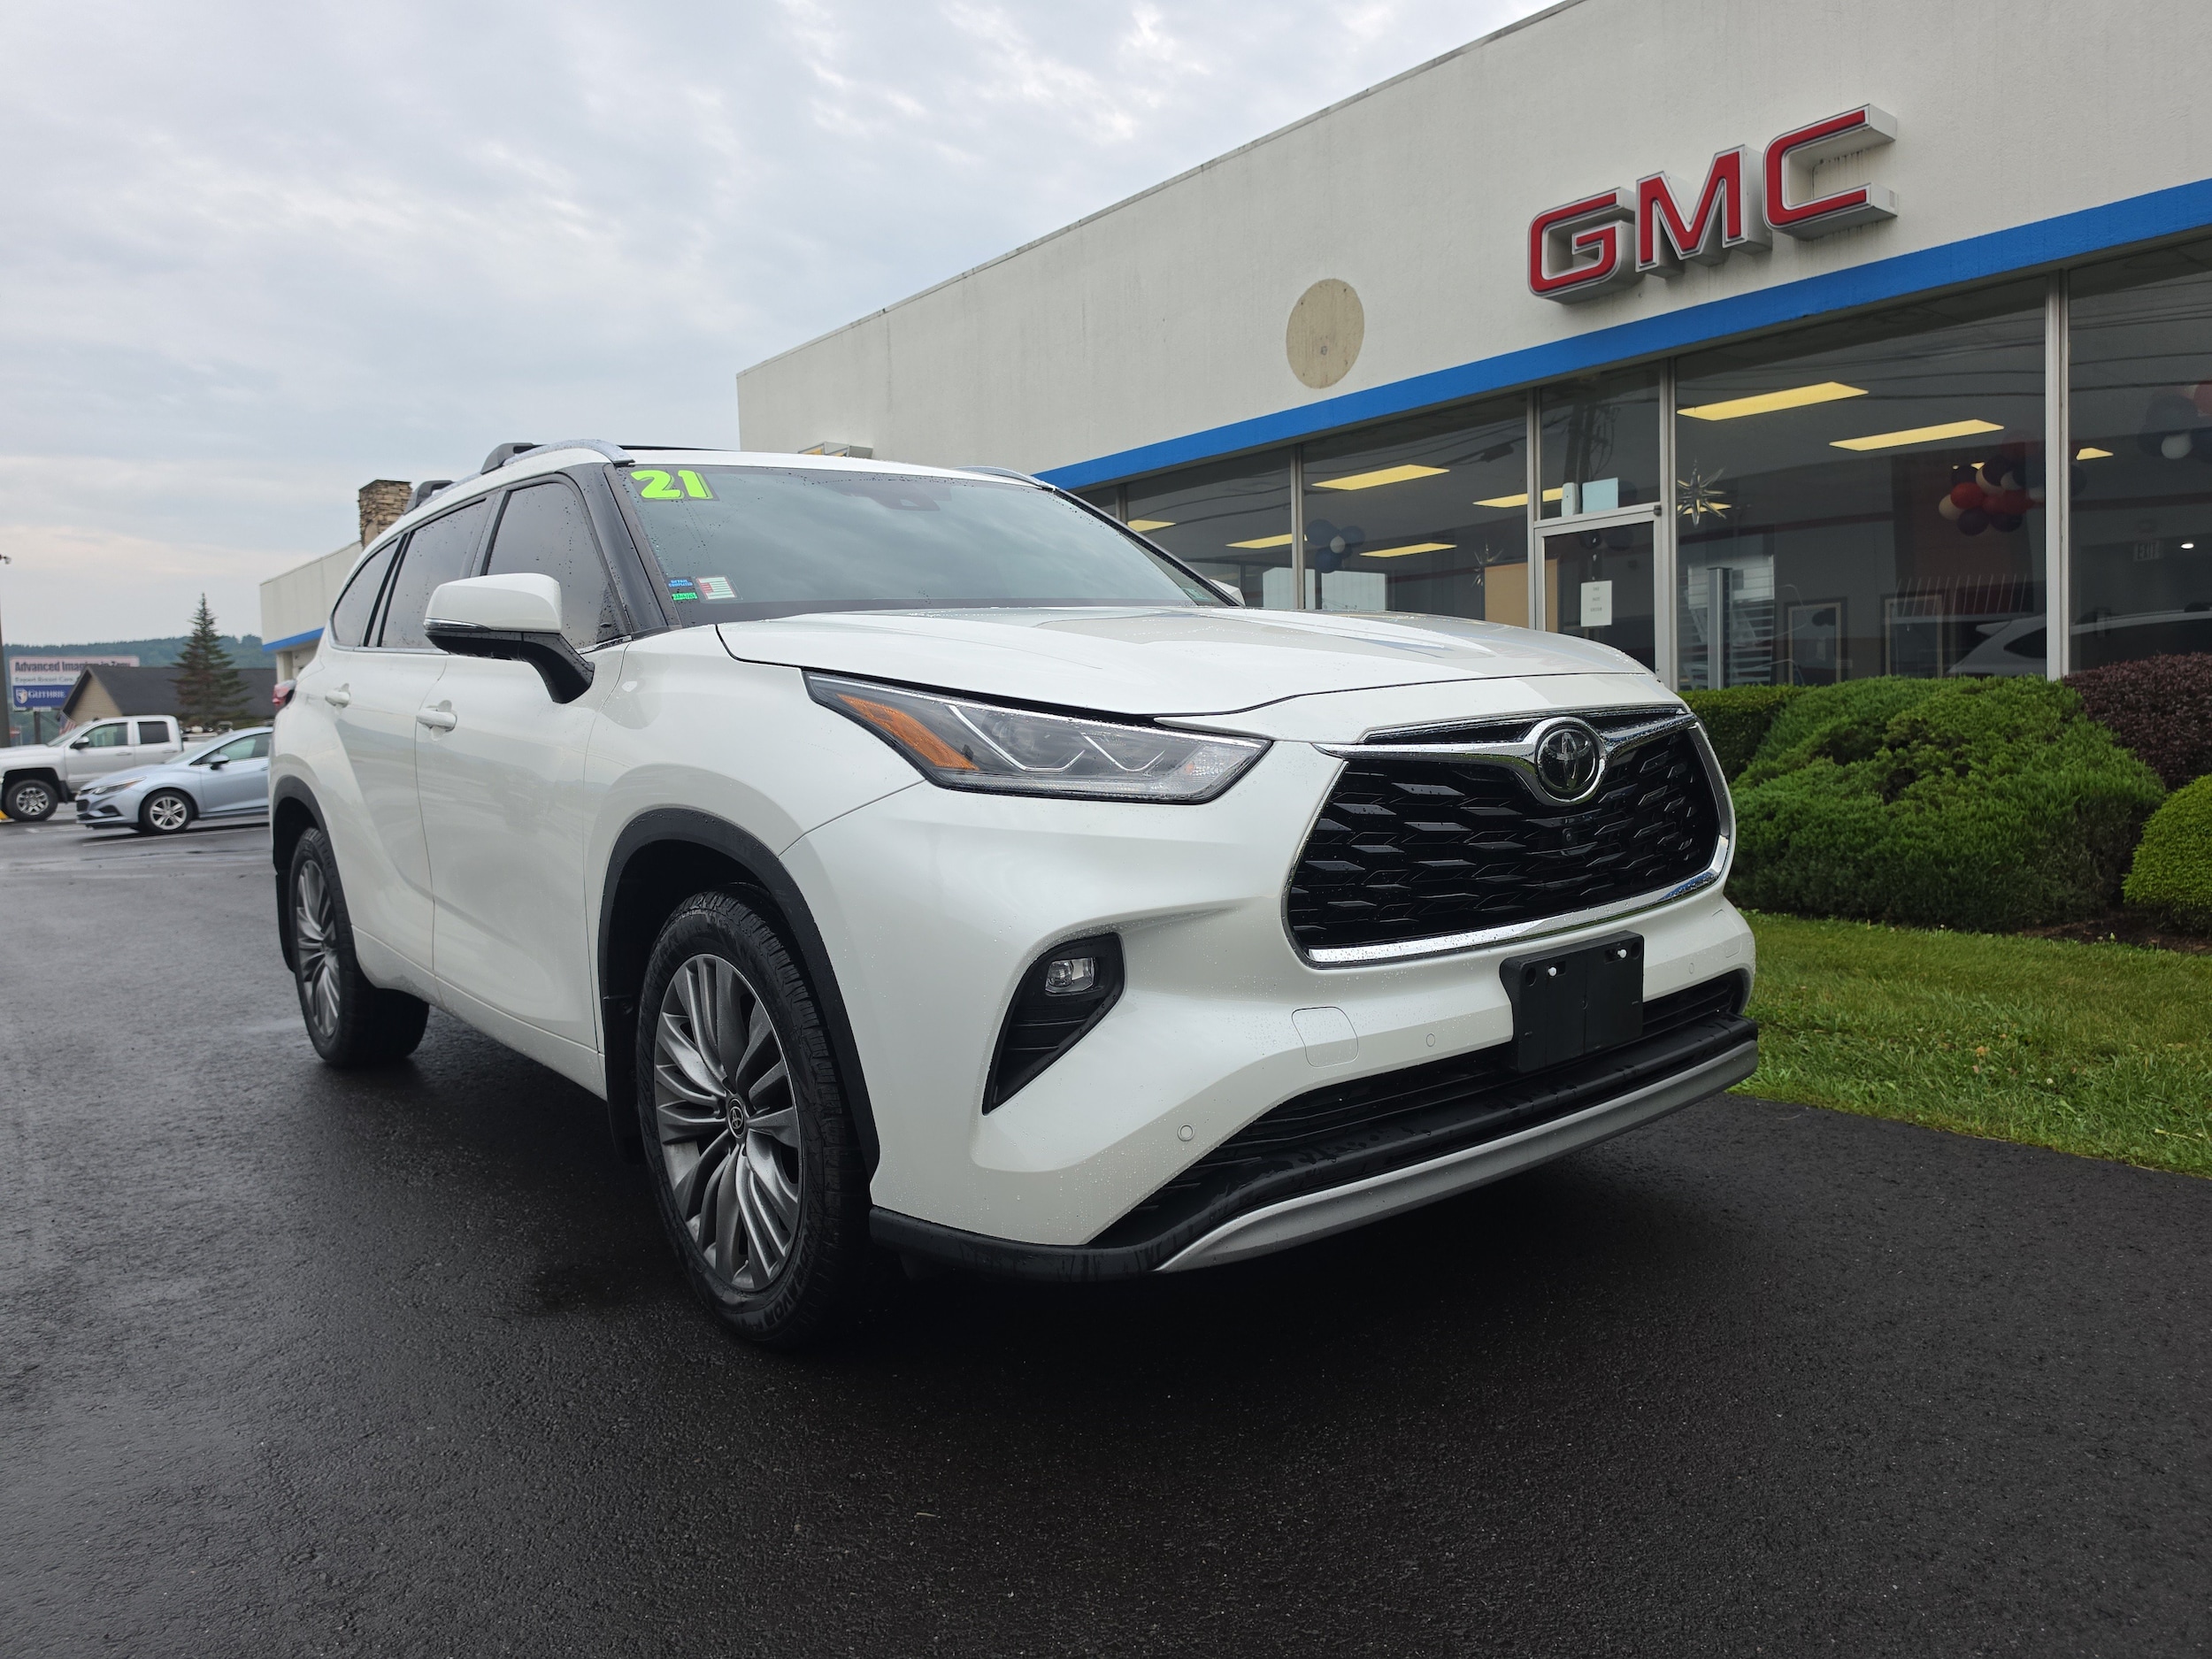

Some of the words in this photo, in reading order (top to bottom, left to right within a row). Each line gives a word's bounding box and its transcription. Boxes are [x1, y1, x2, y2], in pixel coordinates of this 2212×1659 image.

[1528, 104, 1897, 298] GMC
[630, 470, 713, 499] 21
[14, 661, 60, 672] Advanced
[27, 689, 66, 699] GUTHRIE
